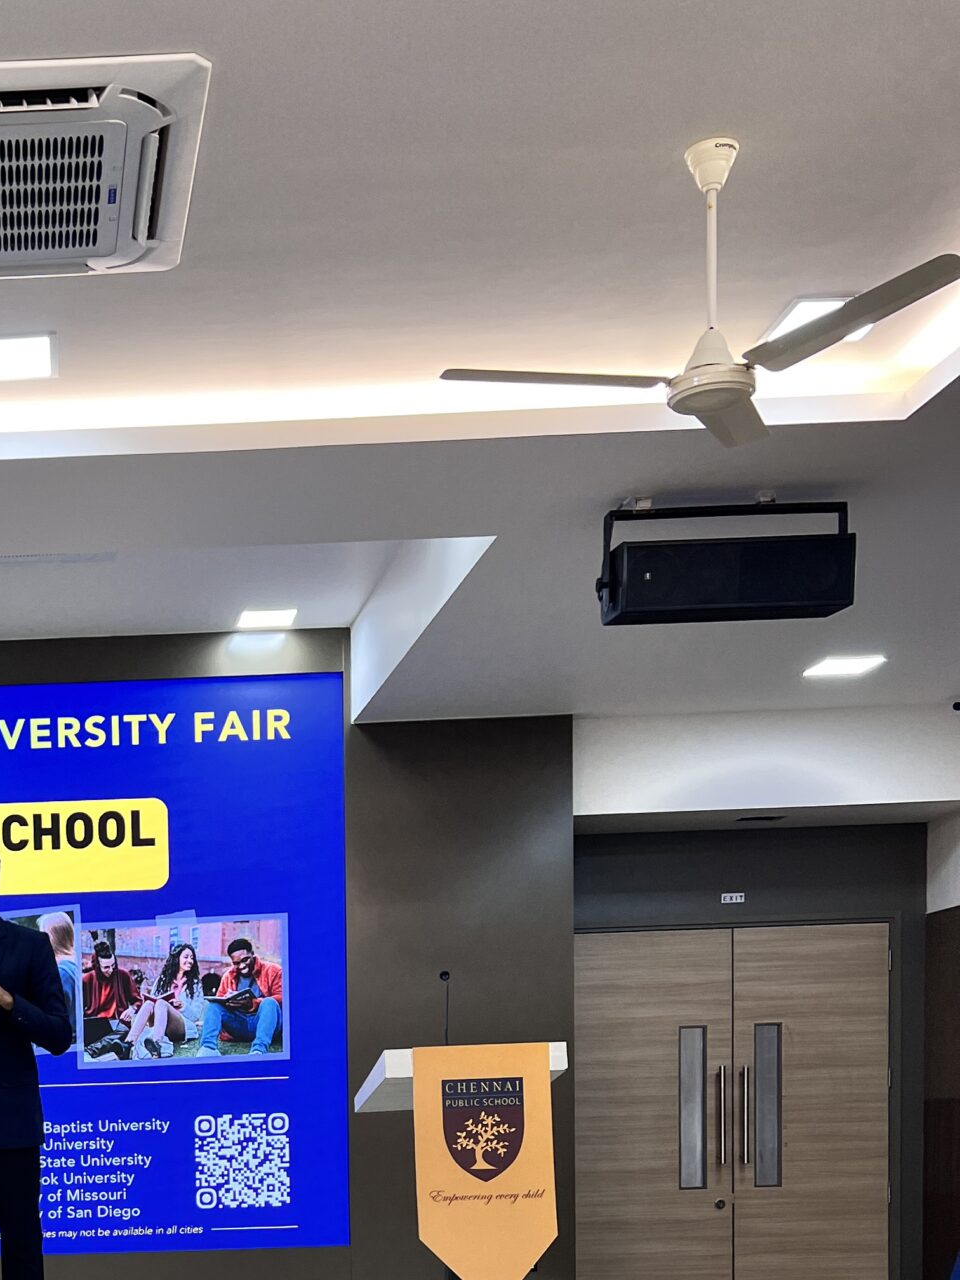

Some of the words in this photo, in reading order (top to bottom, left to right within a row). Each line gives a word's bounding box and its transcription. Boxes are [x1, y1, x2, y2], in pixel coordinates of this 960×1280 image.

[193, 708, 292, 744] FAIR
[445, 1081, 520, 1093] CHENNAI
[445, 1099, 480, 1107] PUBLIC
[483, 1097, 521, 1106] SCHOOL
[42, 1120, 94, 1138] Baptist
[98, 1117, 170, 1134] University
[42, 1137, 115, 1153] University
[39, 1155, 76, 1169] State
[80, 1152, 152, 1169] University
[63, 1170, 135, 1187] University
[47, 1188, 63, 1203] of
[66, 1187, 127, 1202] Missouri
[428, 1189, 493, 1206] Empowering
[495, 1193, 520, 1205] every
[522, 1189, 545, 1200] child
[47, 1205, 63, 1220] of
[66, 1205, 93, 1219] San
[97, 1205, 141, 1221] Diego
[58, 1230, 78, 1240] may
[79, 1229, 96, 1237] not
[97, 1227, 111, 1237] be
[112, 1226, 154, 1237] available
[155, 1227, 164, 1235] in
[165, 1225, 178, 1235] all
[179, 1226, 204, 1235] cities
